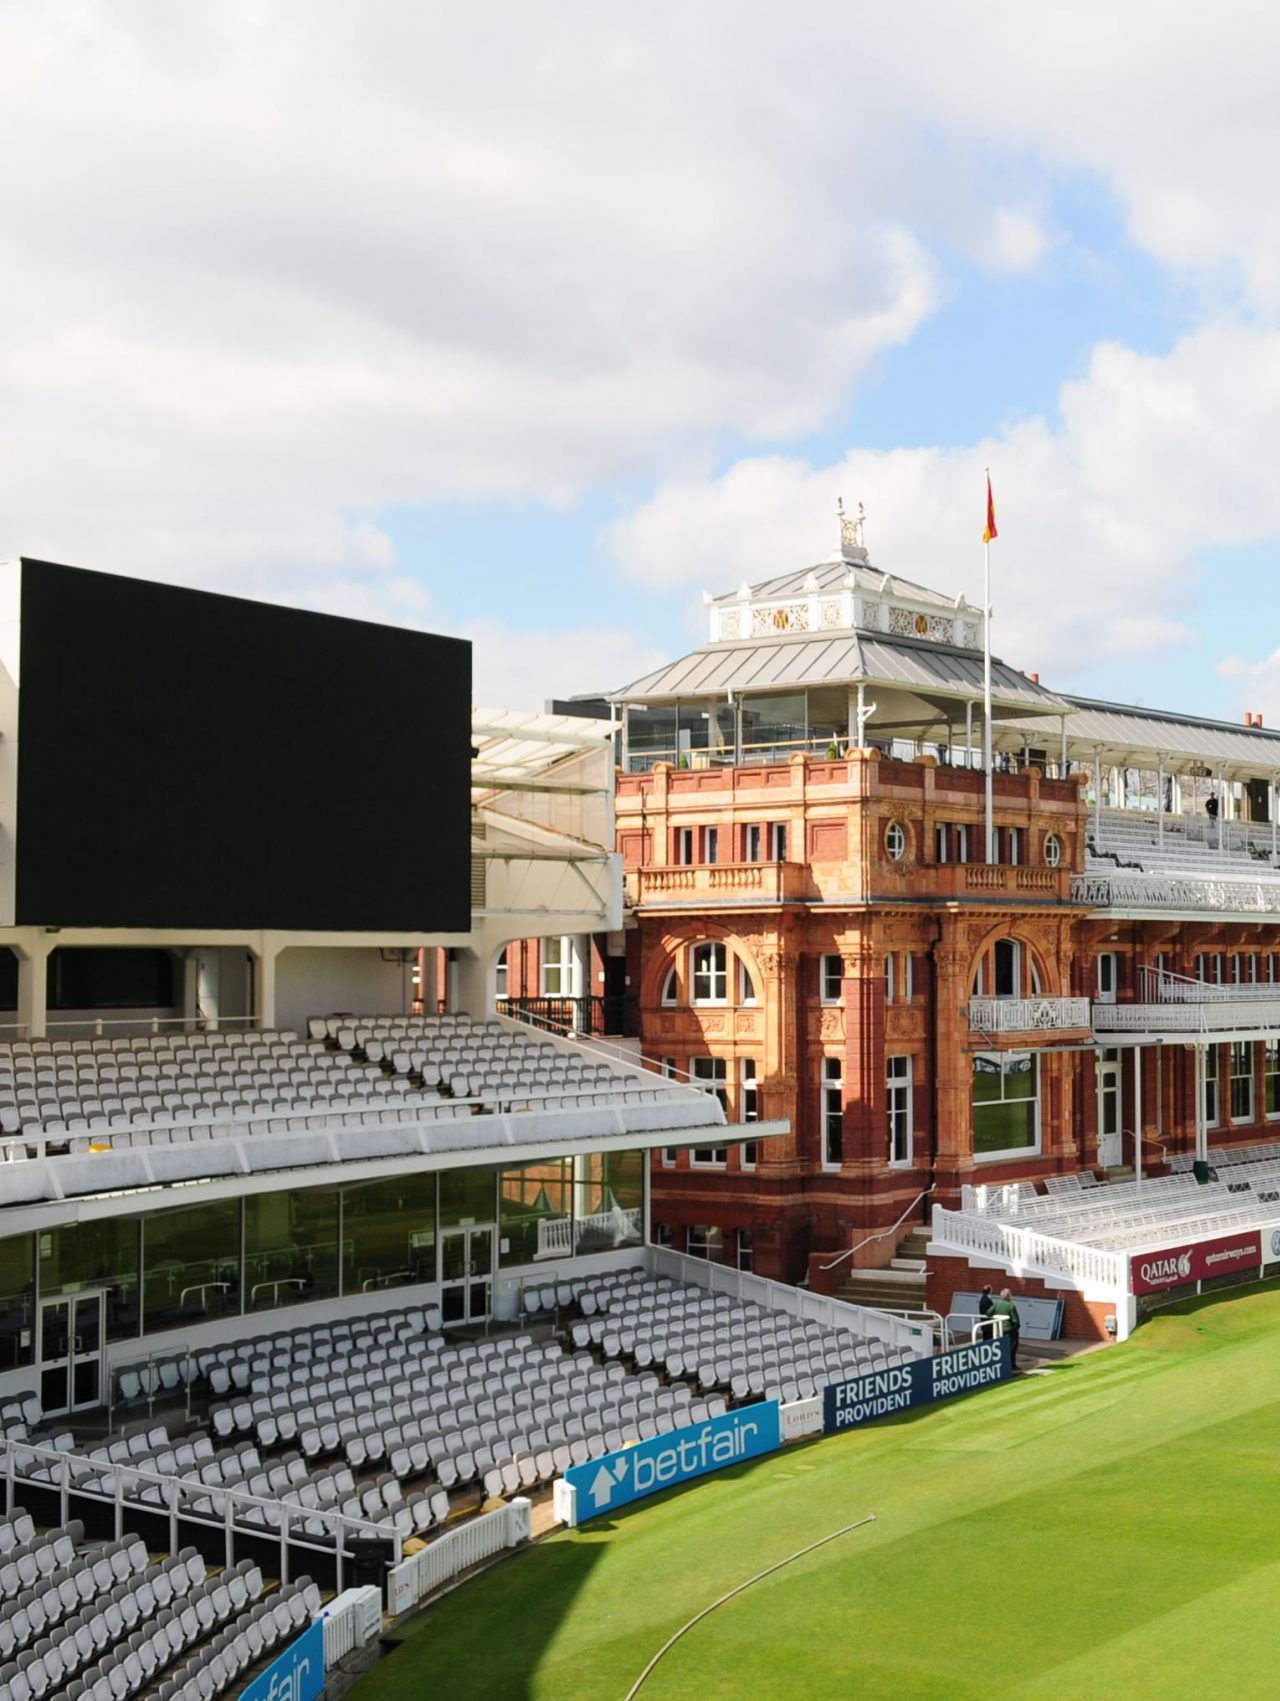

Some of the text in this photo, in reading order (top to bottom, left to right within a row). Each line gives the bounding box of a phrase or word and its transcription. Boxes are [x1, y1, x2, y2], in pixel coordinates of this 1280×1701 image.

[1140, 1257, 1178, 1284] QATAR
[931, 1341, 1002, 1379] FRIENDS
[835, 1366, 913, 1408] FRIENDS
[932, 1363, 1003, 1398] PROVIDENT
[835, 1389, 913, 1428] PROVIDENT
[633, 1416, 759, 1493] betfair
